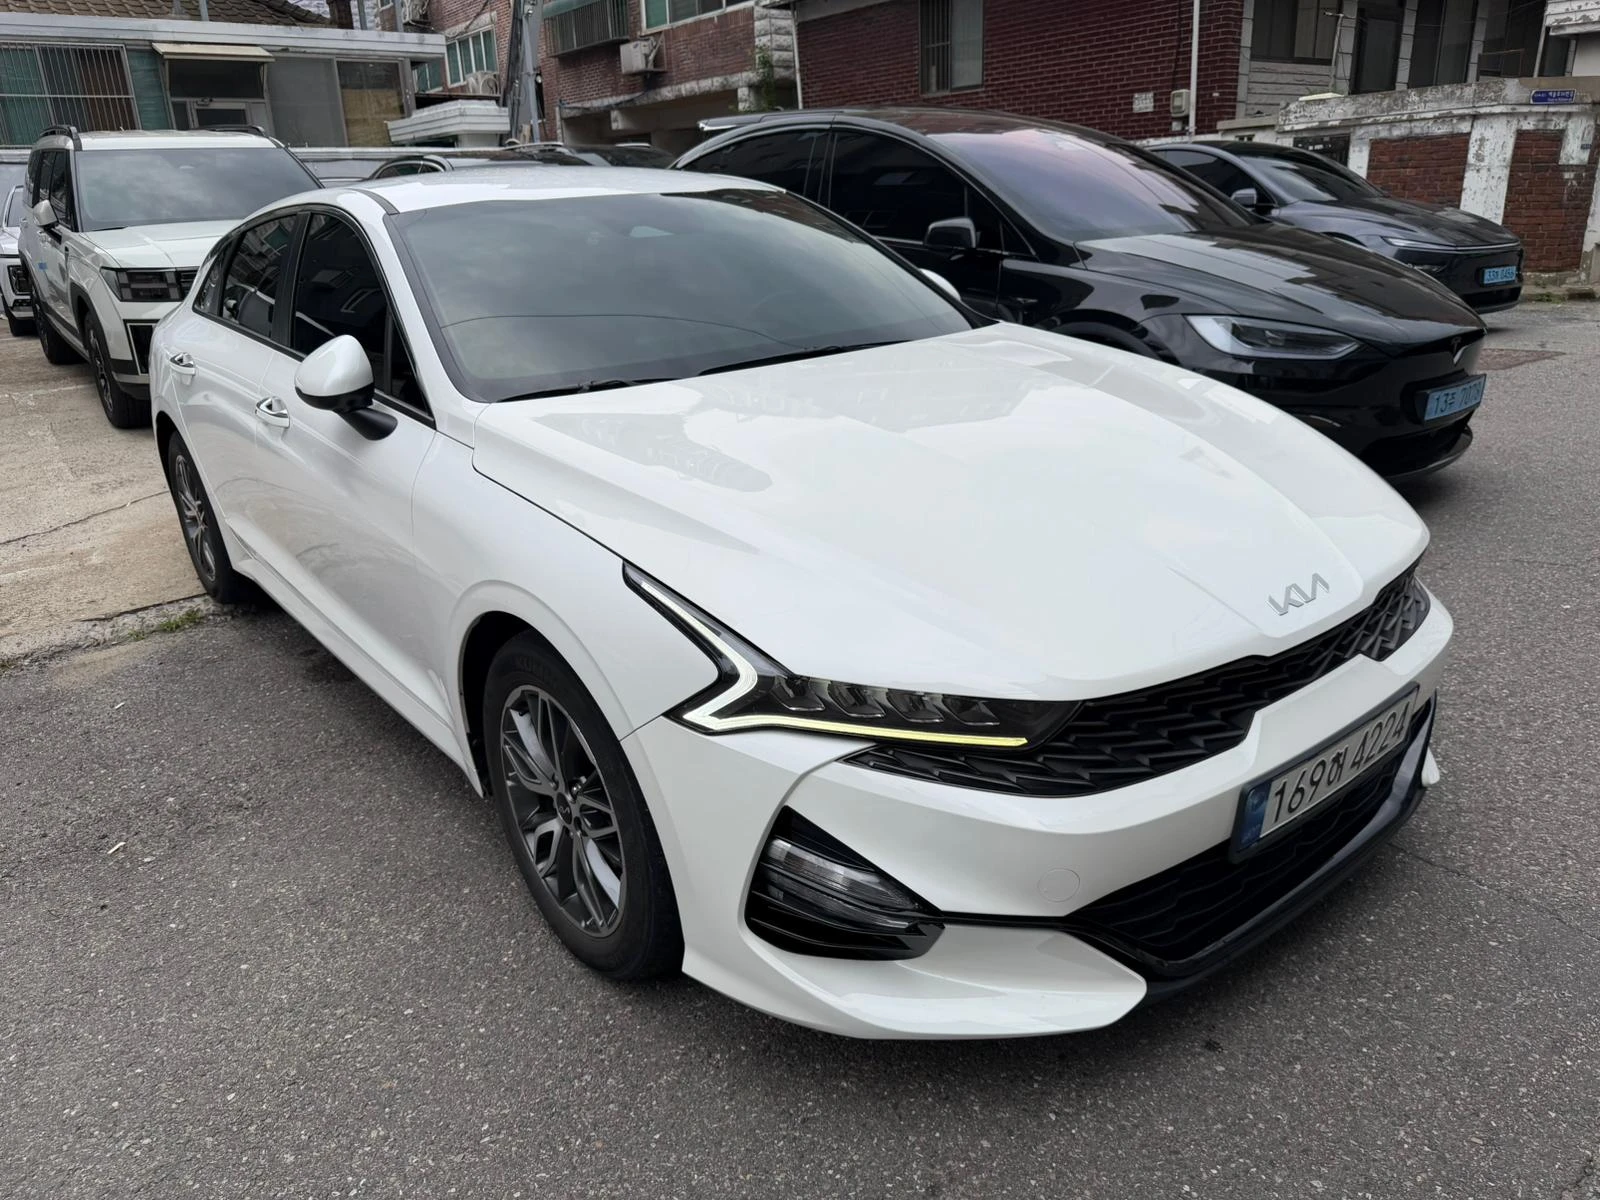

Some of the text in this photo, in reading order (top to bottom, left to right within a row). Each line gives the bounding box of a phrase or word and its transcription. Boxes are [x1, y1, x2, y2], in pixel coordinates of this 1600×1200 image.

[1266, 573, 1329, 616] KIA
[1274, 701, 1410, 823] 169허 4224
